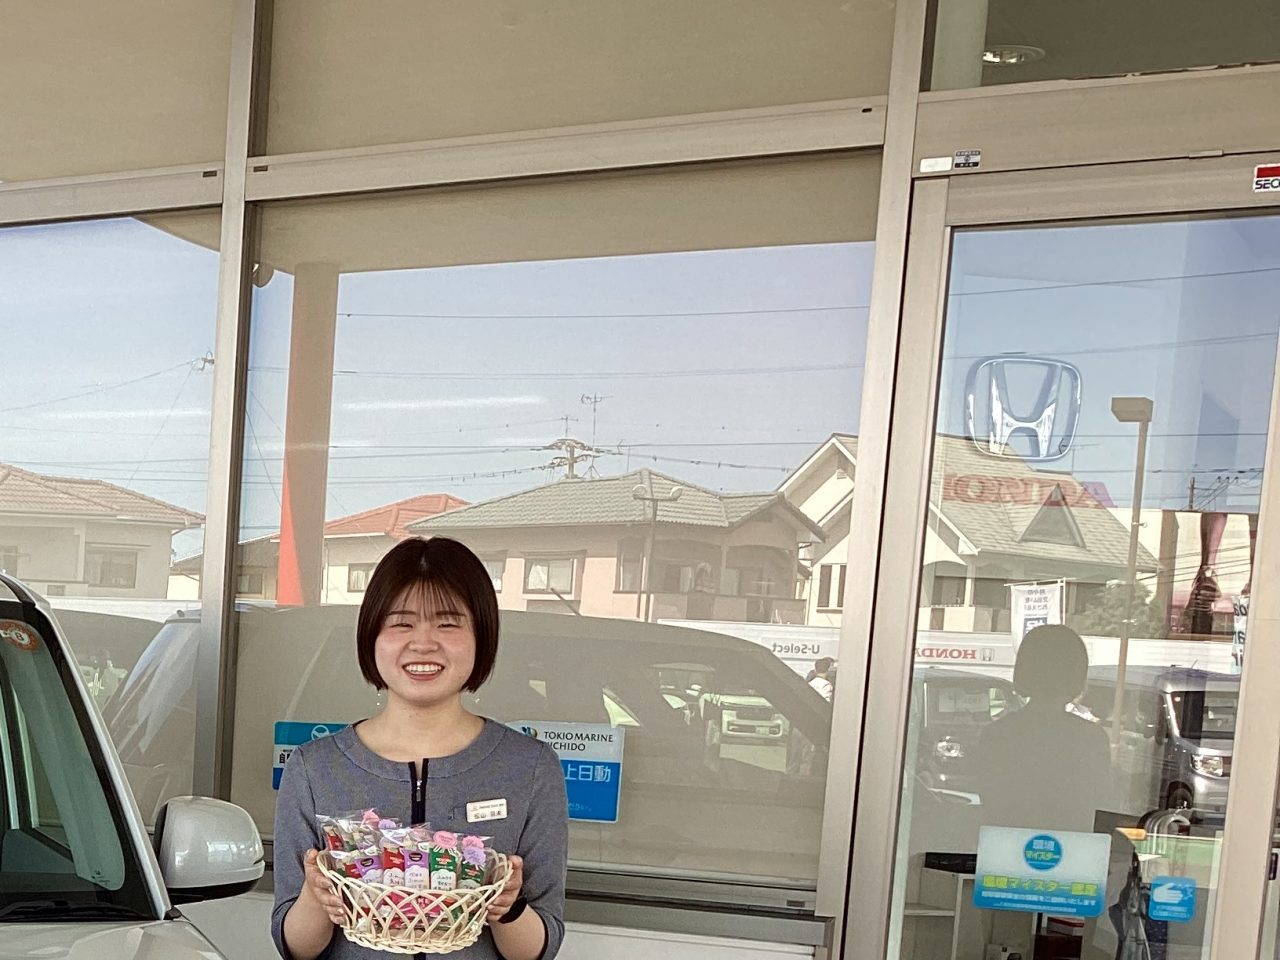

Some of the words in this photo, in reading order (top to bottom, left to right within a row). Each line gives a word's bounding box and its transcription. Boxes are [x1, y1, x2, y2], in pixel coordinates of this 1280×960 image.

[1255, 178, 1280, 190] SEC
[544, 731, 573, 741] TOKIO
[574, 733, 613, 742] MARINE
[548, 742, 585, 751] ICHIDO
[565, 764, 612, 782] 上日動
